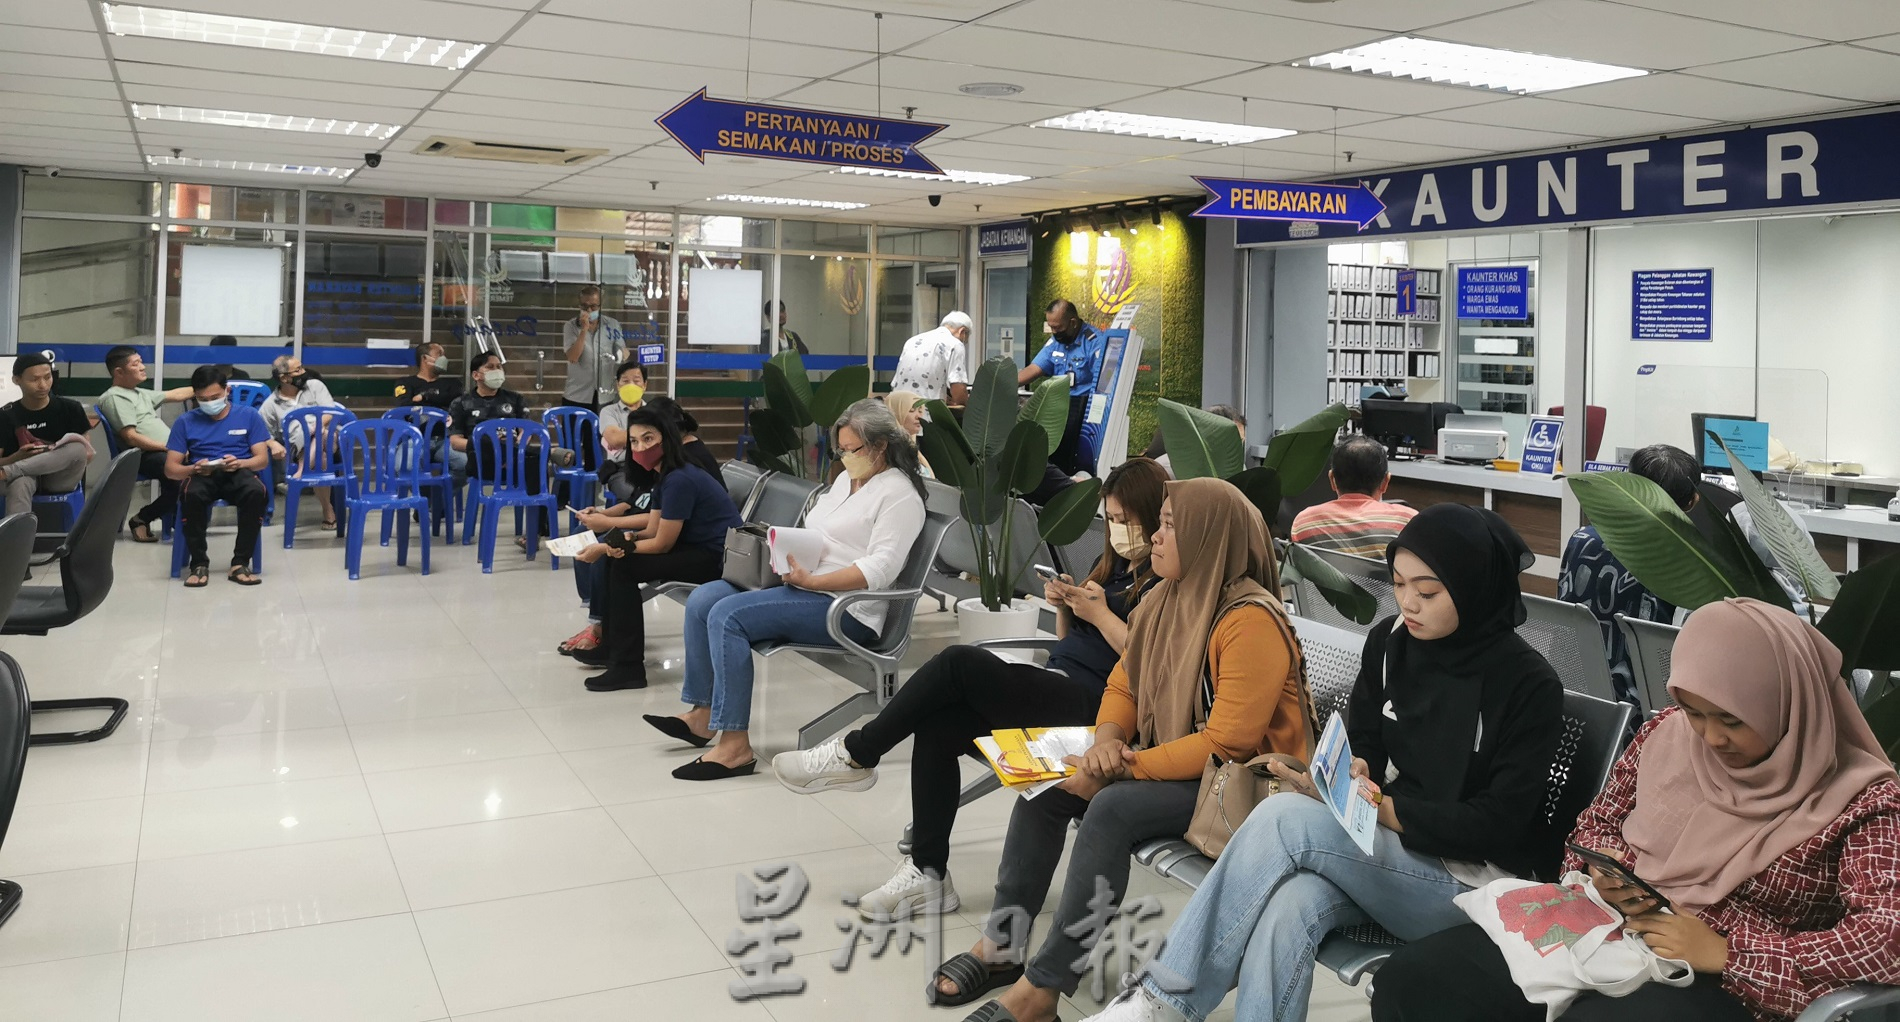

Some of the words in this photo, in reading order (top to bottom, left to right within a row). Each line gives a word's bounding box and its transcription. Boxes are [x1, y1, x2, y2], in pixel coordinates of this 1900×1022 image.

[745, 110, 871, 139] PERTANYAAN
[717, 129, 816, 156] SEMAKAN
[831, 141, 904, 164] PROSES
[1364, 130, 1820, 229] KAUNTER
[1230, 187, 1347, 214] PEMBAYARAN
[1466, 272, 1498, 281] KAUNTER
[1499, 271, 1518, 281] KHAS
[1466, 285, 1484, 294] ORANG
[1485, 285, 1505, 294] KURANG
[1402, 284, 1410, 310] 1
[1485, 295, 1499, 304] EMAS
[1485, 305, 1518, 314] MENGANDUNG
[1525, 454, 1552, 463] KAUNTER
[1530, 462, 1544, 470] OKU
